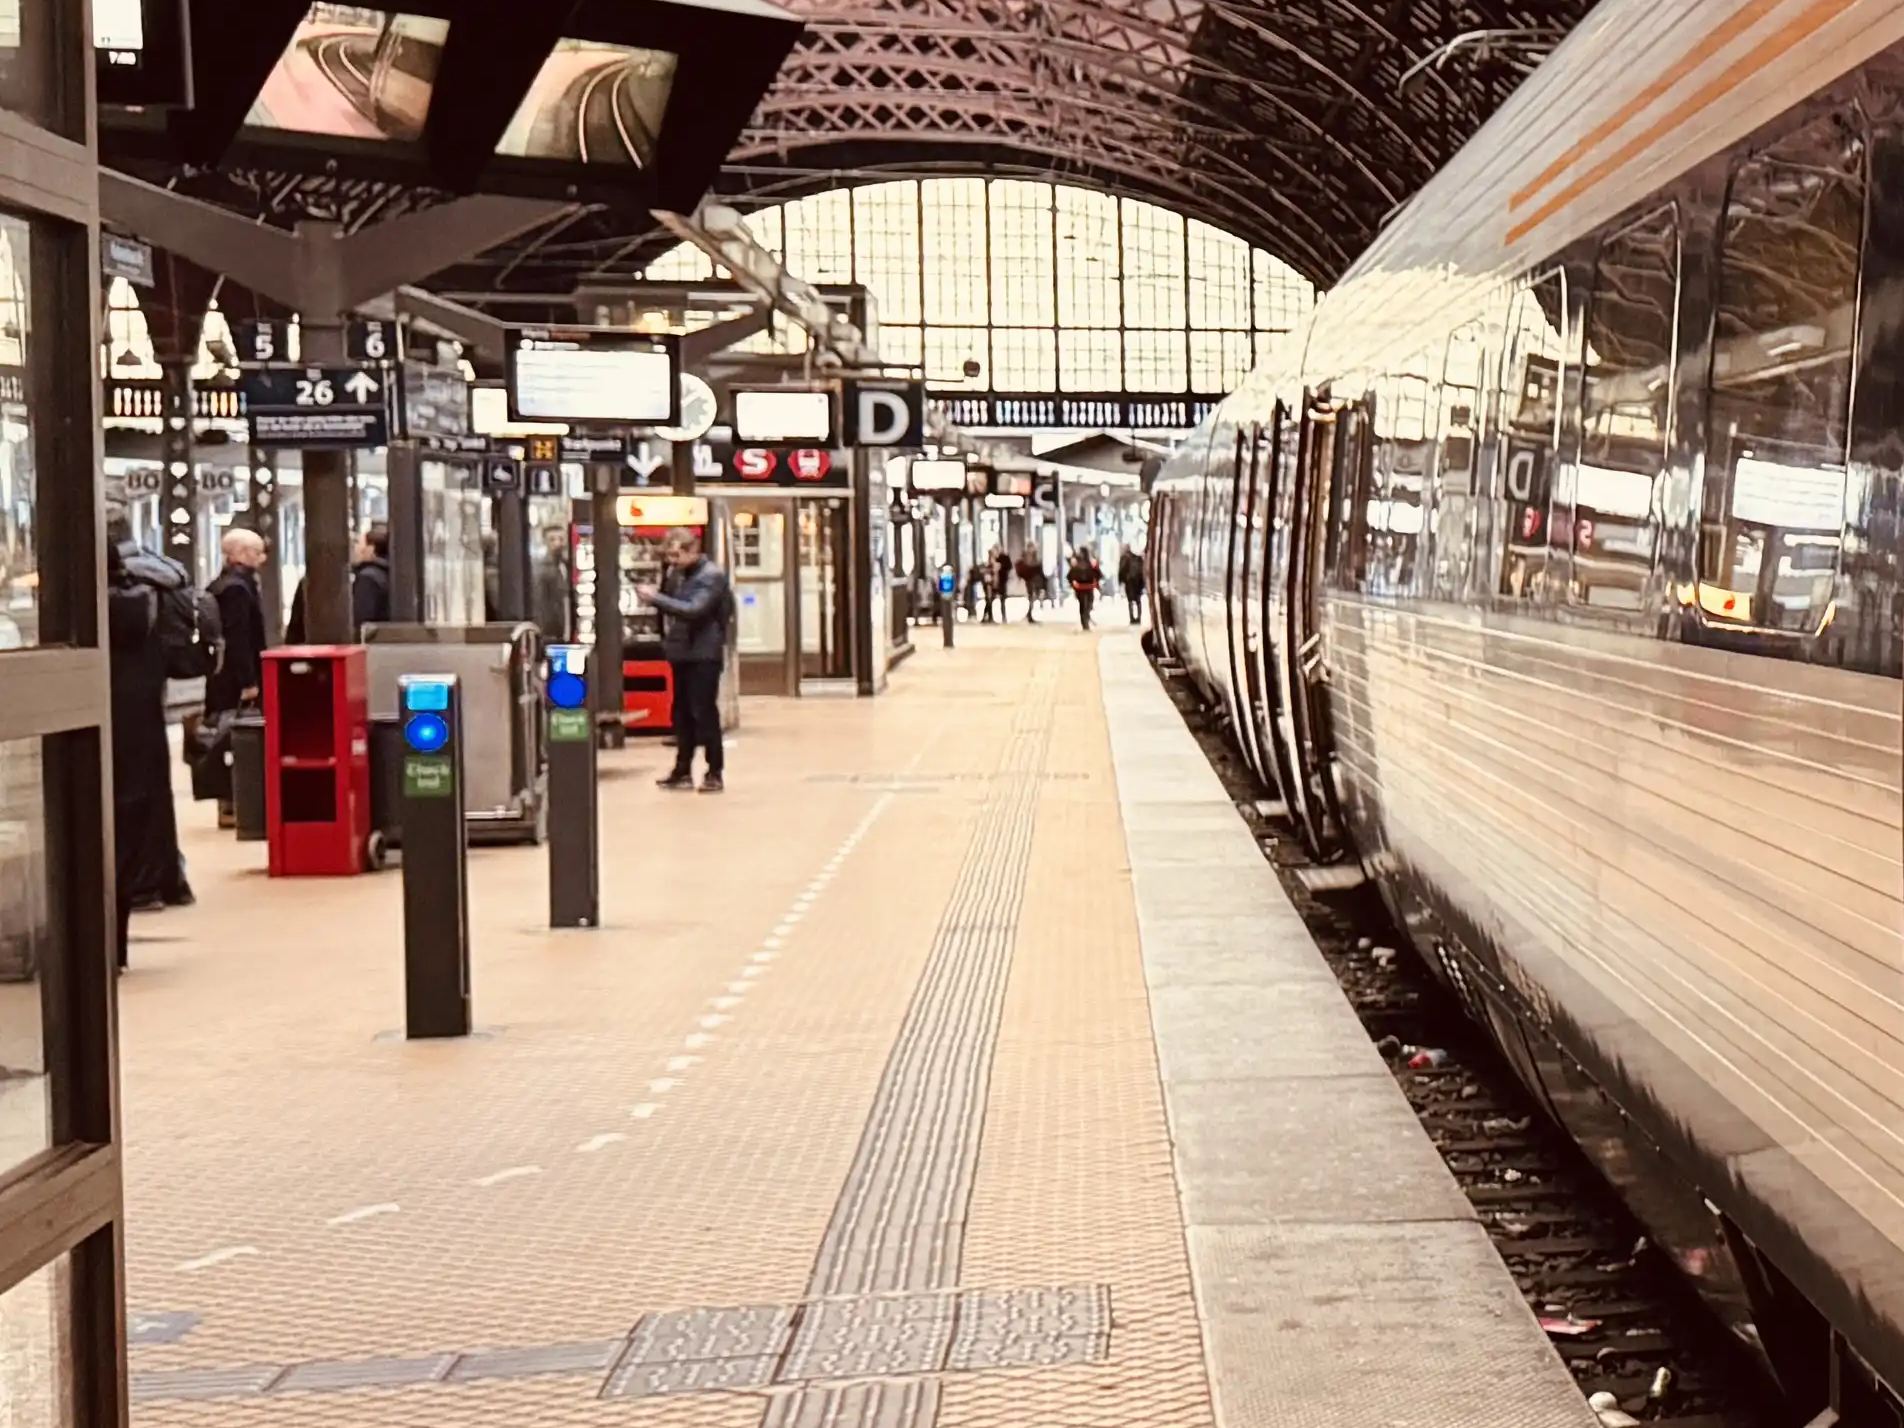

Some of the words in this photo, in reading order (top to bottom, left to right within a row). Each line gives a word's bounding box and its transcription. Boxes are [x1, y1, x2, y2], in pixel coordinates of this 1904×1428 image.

[255, 334, 274, 359] 5
[366, 332, 385, 358] 6
[296, 380, 334, 406] 26
[858, 390, 910, 444] D
[742, 448, 768, 474] S
